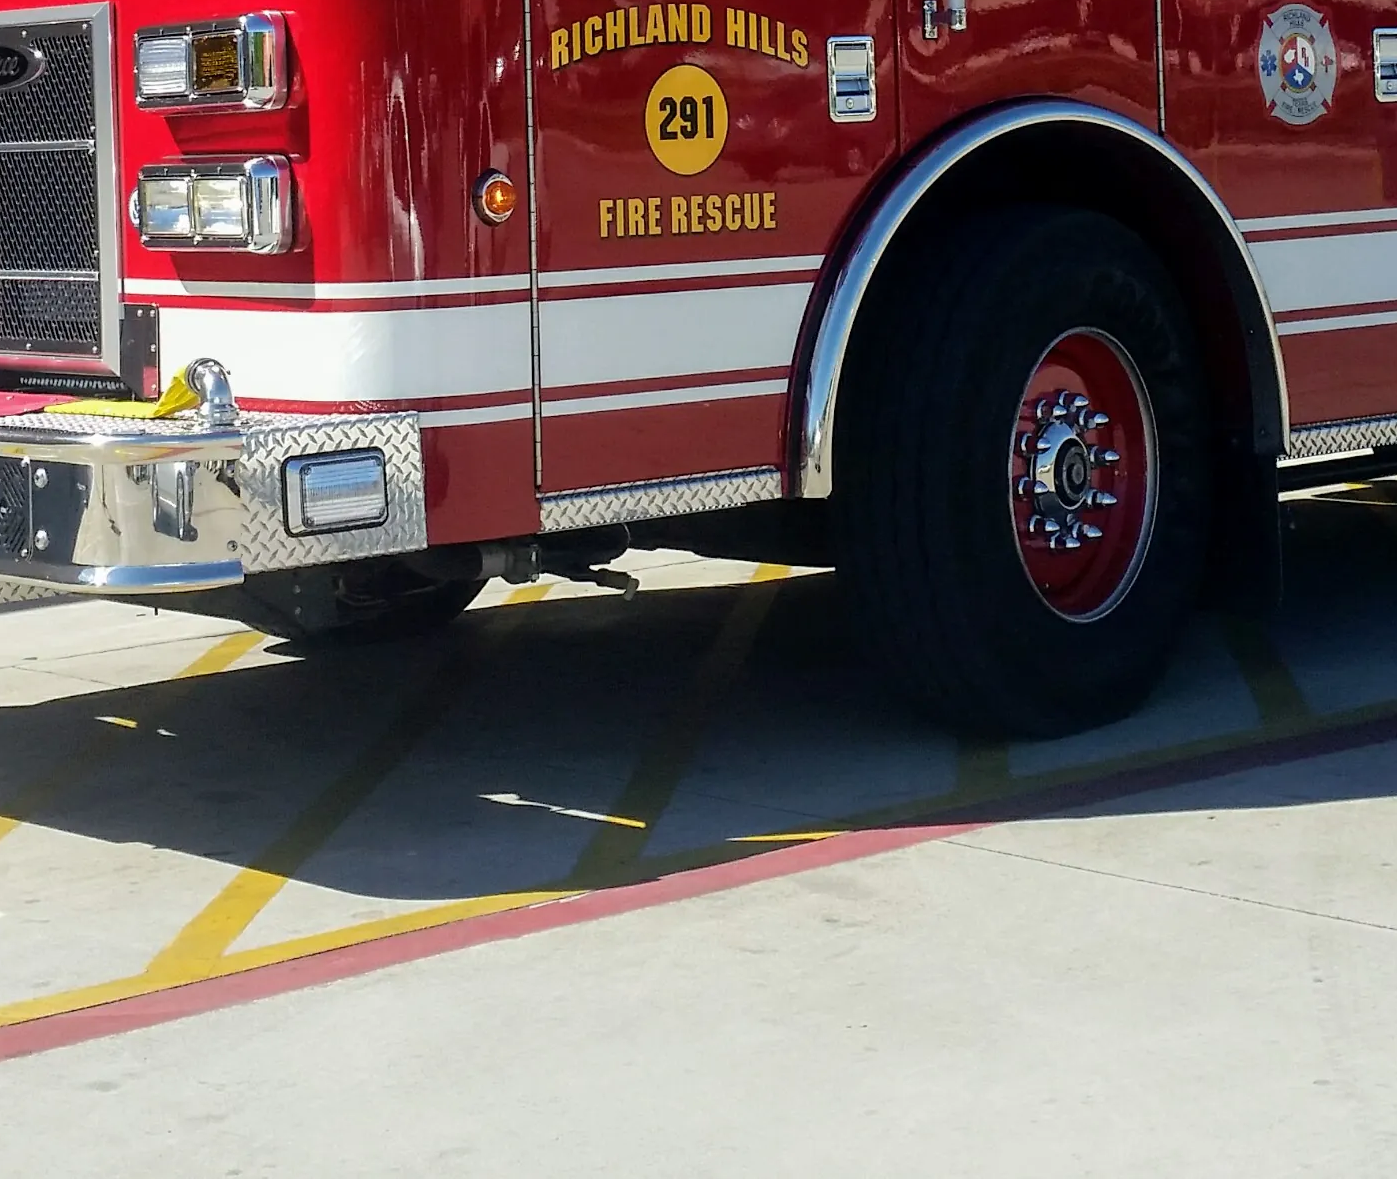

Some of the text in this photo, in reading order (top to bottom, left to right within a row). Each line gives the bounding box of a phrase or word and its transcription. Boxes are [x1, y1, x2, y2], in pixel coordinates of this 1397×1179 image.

[551, 3, 809, 70] RICHLAND HILLS
[658, 95, 715, 141] 291
[599, 192, 776, 238] FIRE RESCUE
